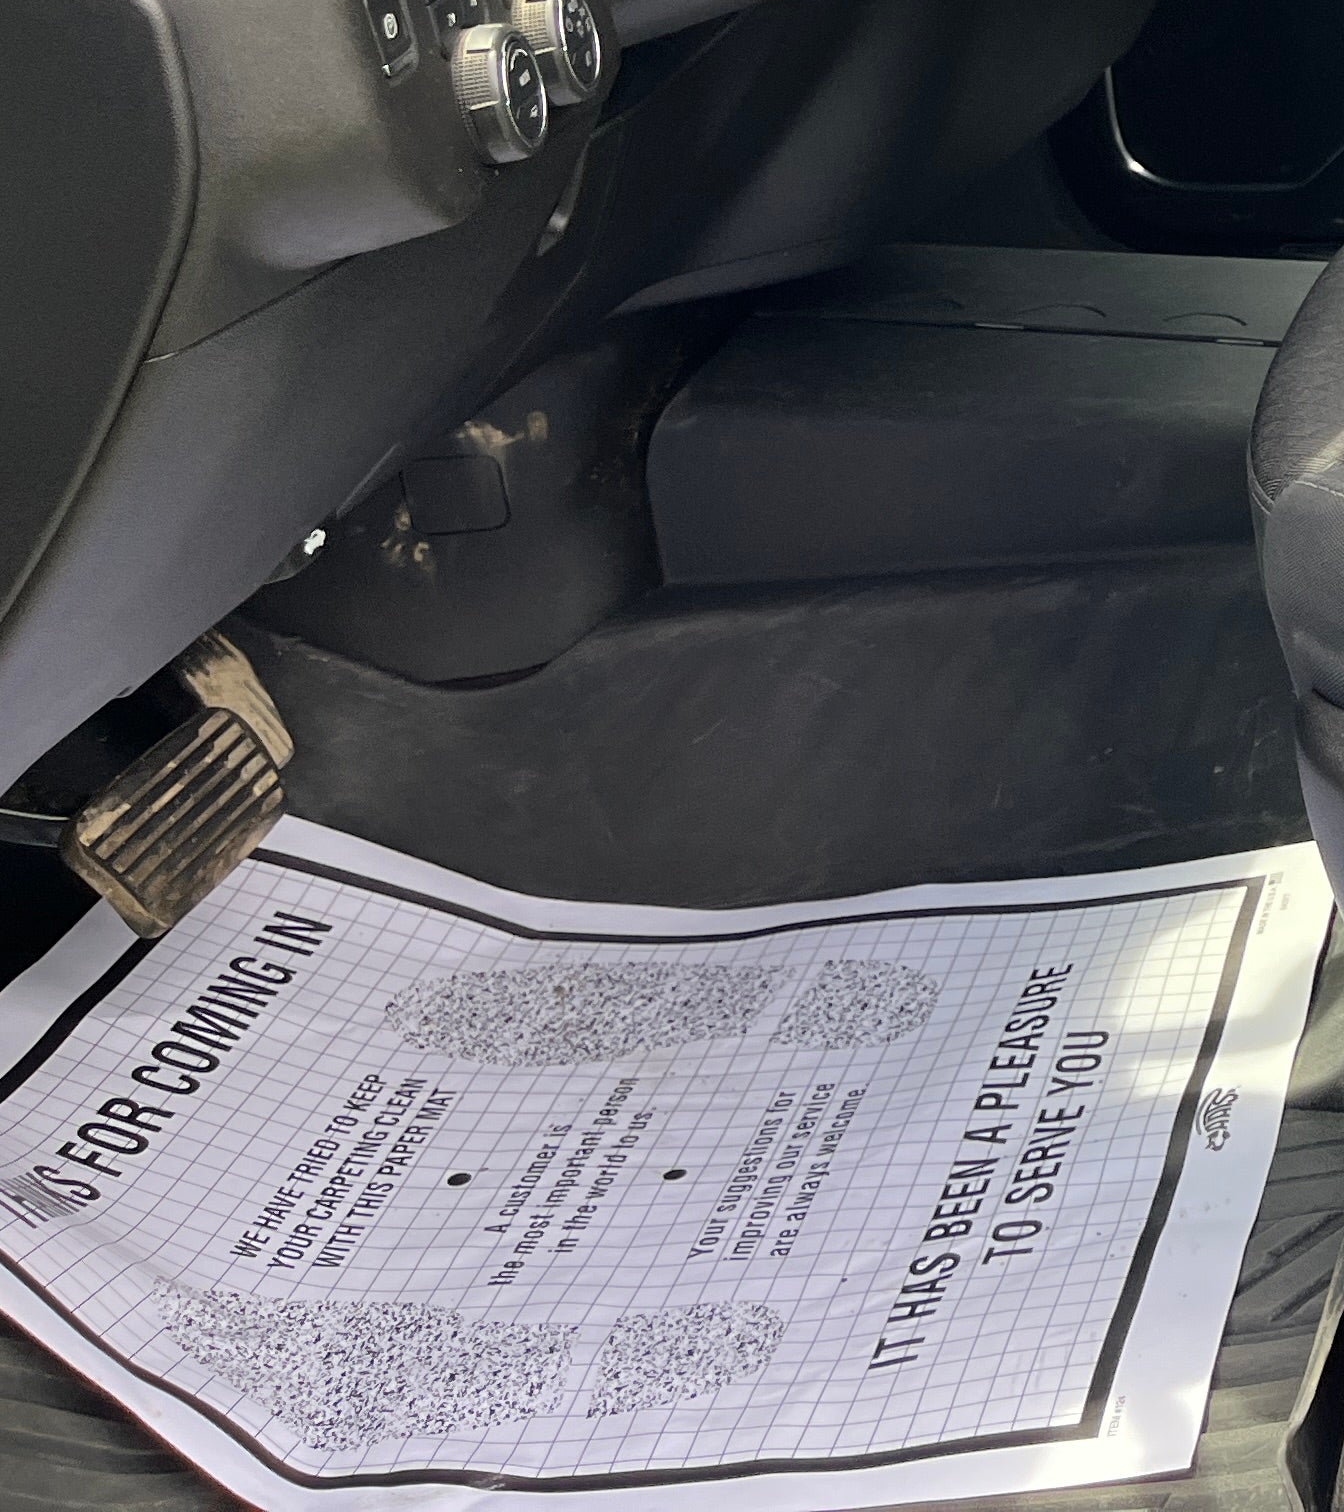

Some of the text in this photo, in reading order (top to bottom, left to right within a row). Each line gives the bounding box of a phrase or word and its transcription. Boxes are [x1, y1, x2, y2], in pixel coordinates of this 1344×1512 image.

[56, 1097, 175, 1177] FOR
[132, 956, 297, 1094] COMING
[254, 911, 332, 956] IN
[230, 1074, 386, 1258] WE HAVE TRIED TO KEEP
[267, 1078, 427, 1269] YOUR CARPETING CLEAN
[312, 1088, 456, 1267] WITH THIS PAPER MAT
[484, 1124, 572, 1233] A customer is
[487, 1078, 639, 1286] the most important person
[548, 1107, 657, 1252] in the world to us.
[687, 1091, 796, 1260] Your suggestions for
[723, 1083, 835, 1261] improving our service
[770, 1083, 870, 1257] are always welcome.
[868, 963, 1073, 1370] IT HAS BEEN A PLEASURE
[982, 1031, 1110, 1265] TO SERVE YOU
